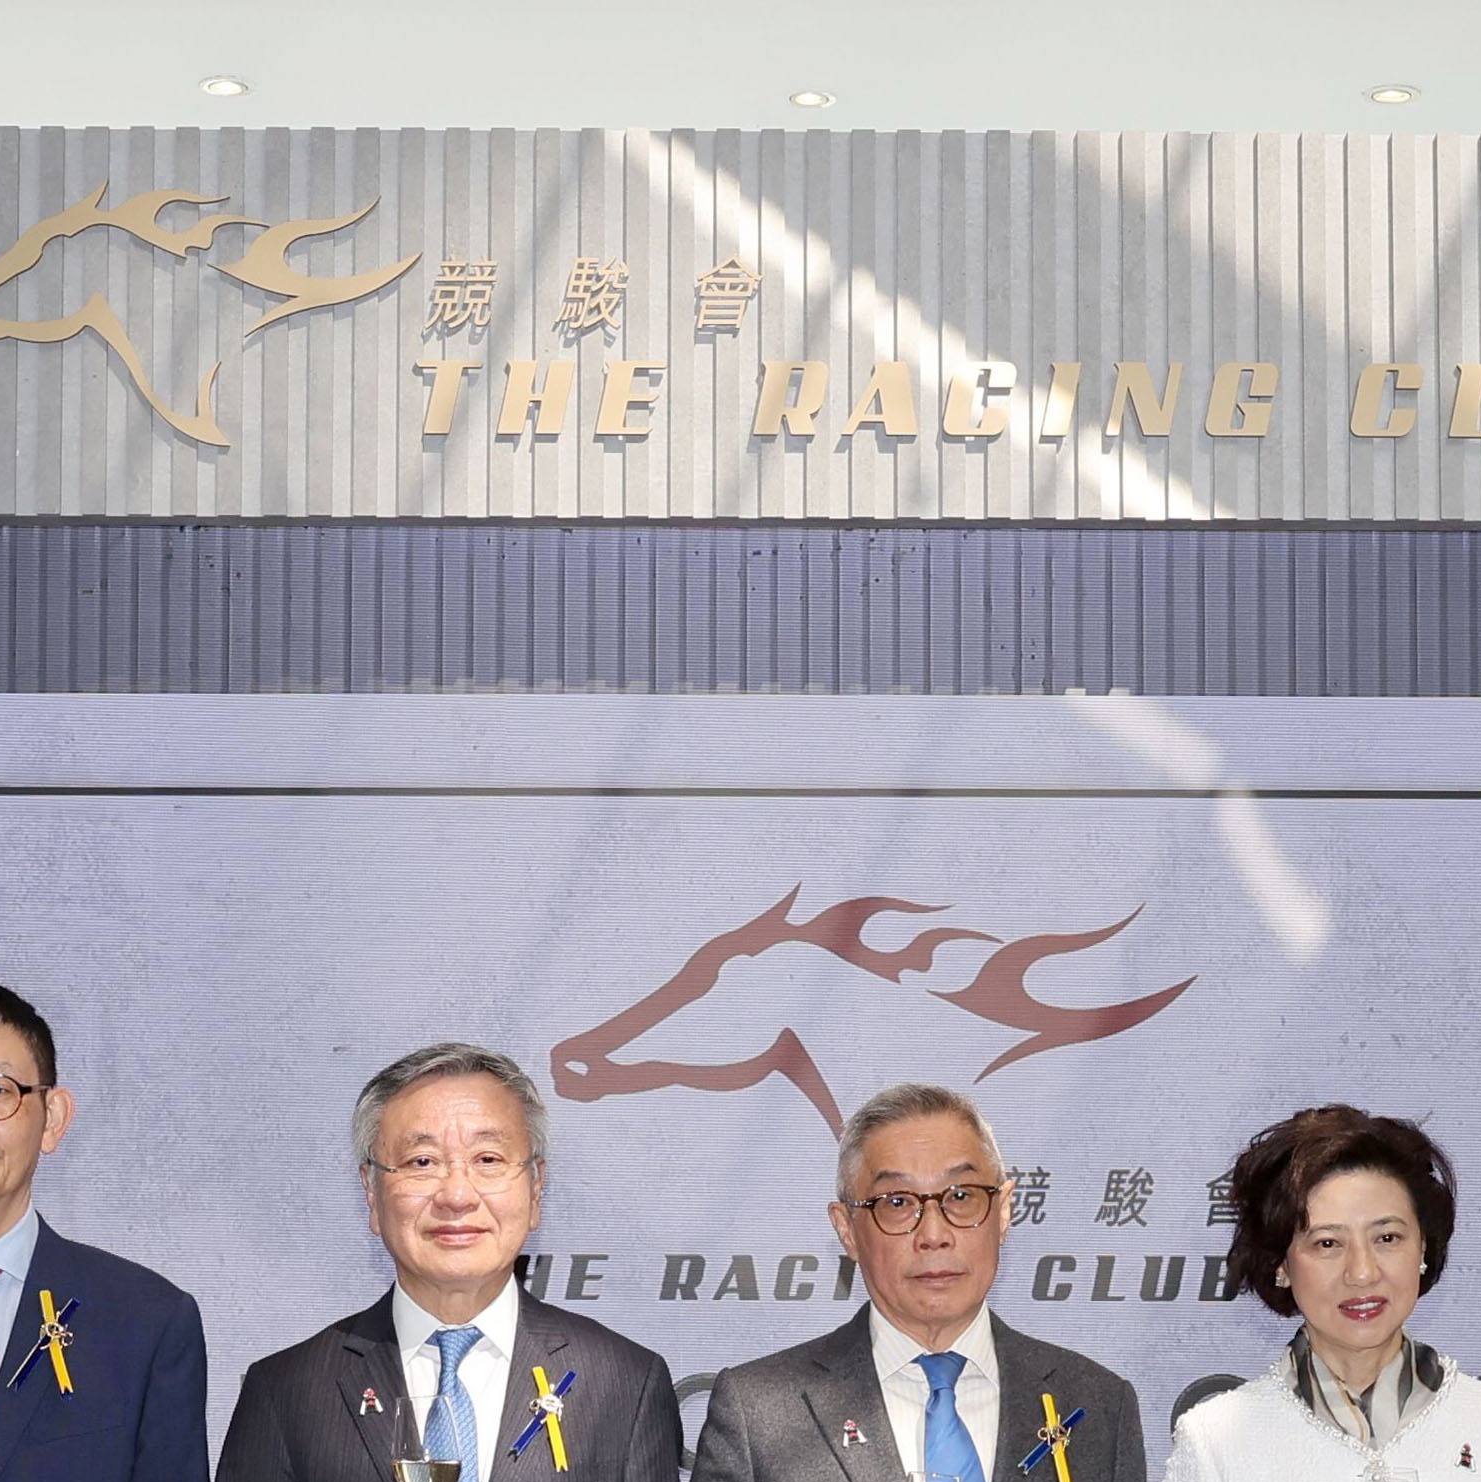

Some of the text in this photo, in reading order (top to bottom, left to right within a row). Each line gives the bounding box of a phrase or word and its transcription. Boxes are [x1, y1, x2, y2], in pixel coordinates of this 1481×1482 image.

[424, 253, 763, 330] 競駿會
[415, 359, 669, 436] THE
[752, 360, 1281, 438] RACING
[513, 1253, 609, 1301] HE
[658, 1253, 856, 1301] RACI
